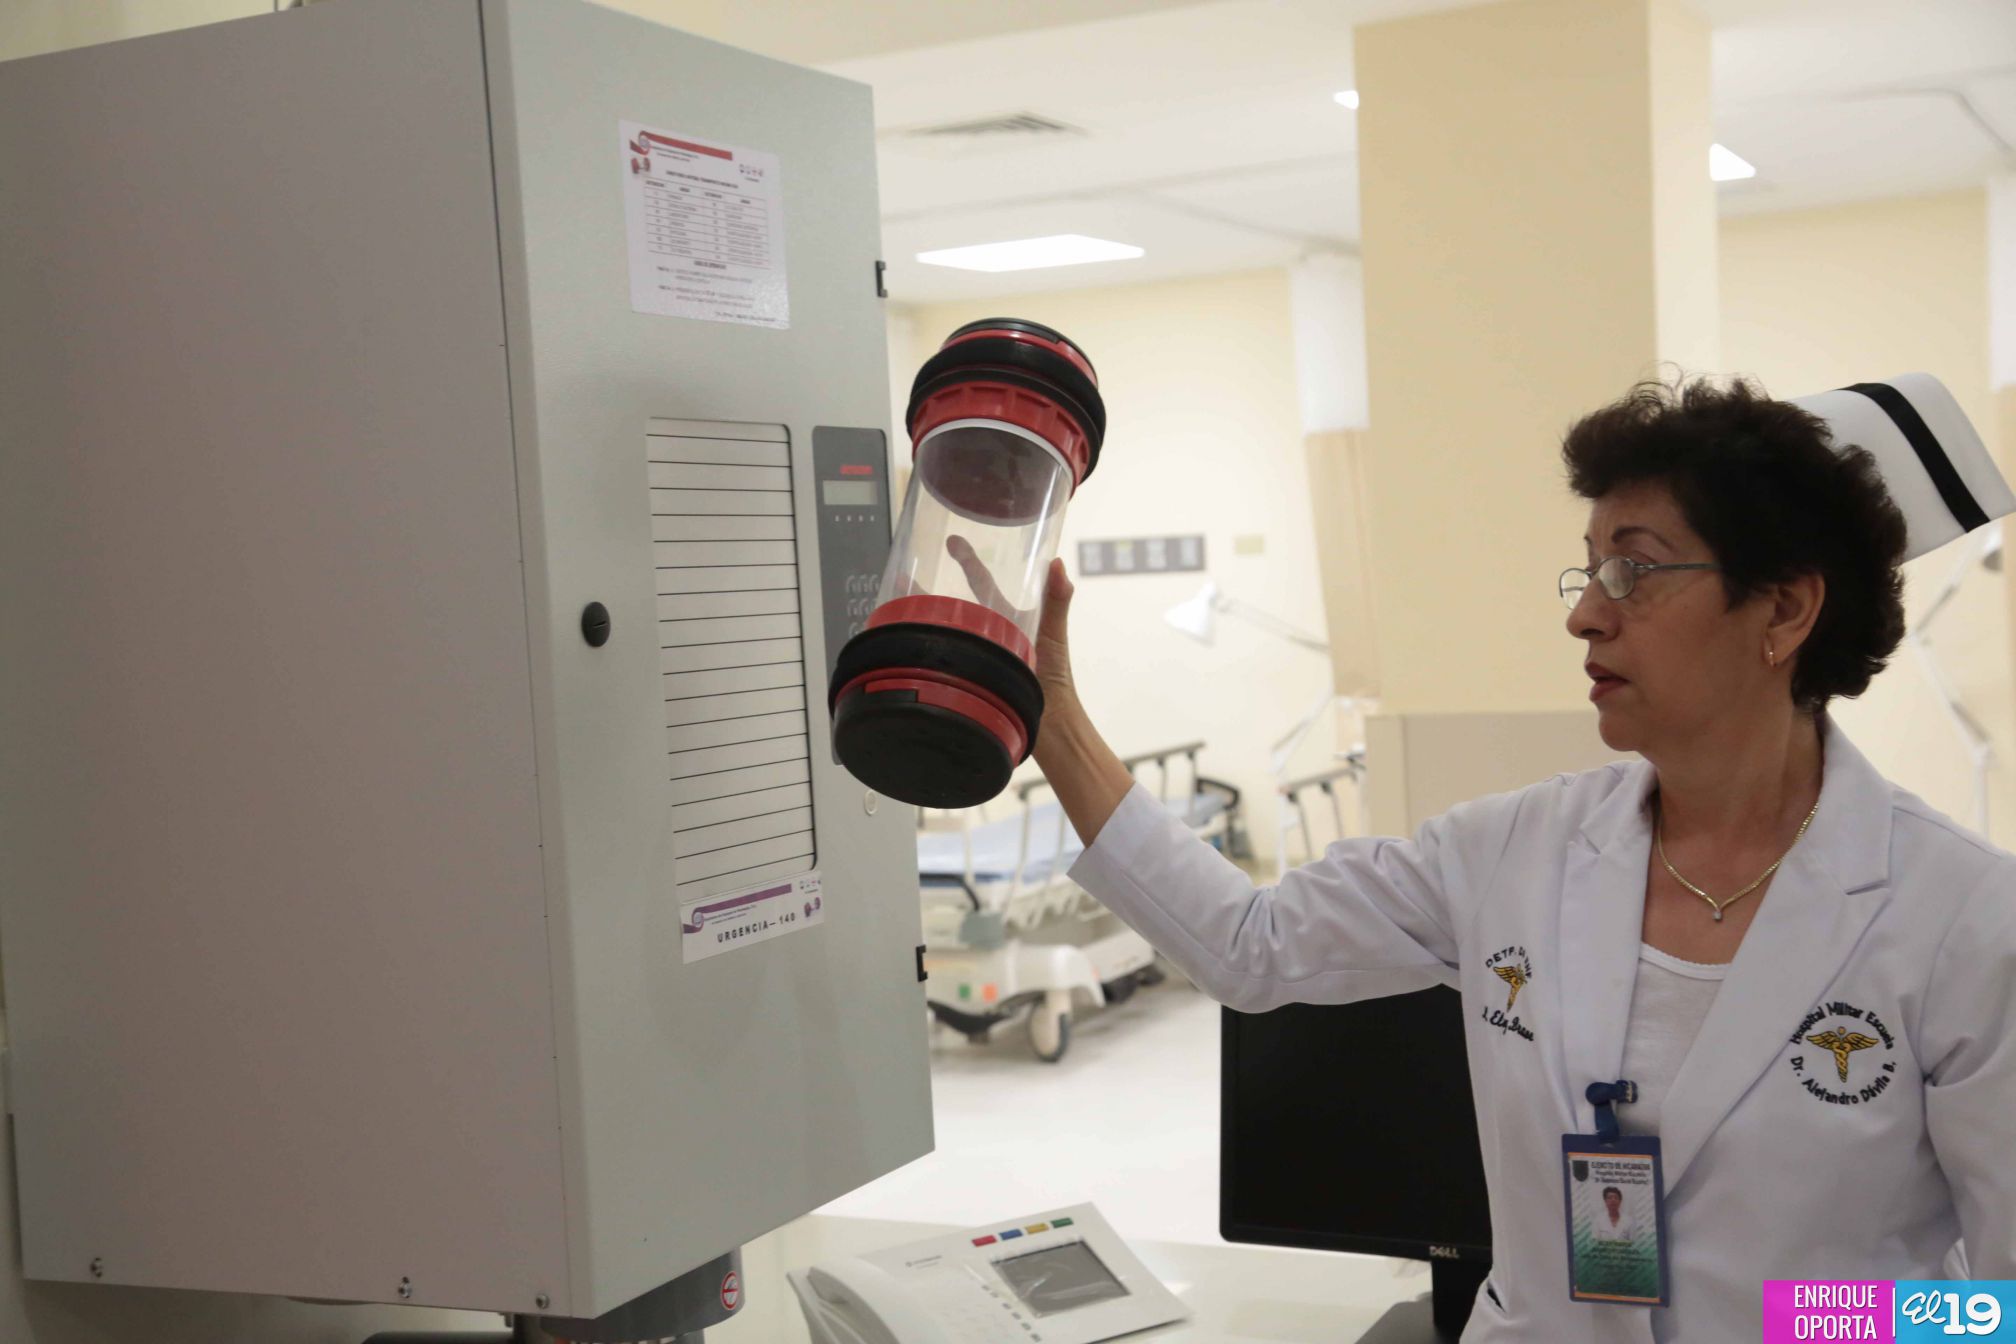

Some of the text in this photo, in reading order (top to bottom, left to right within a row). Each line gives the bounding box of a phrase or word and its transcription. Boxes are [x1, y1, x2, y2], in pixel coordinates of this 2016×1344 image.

[1790, 1006, 1826, 1045] Hospital
[1826, 1002, 1864, 1019] Militar
[1791, 1056, 1804, 1077] Dr.
[1802, 1079, 1859, 1105] Alejandro
[1429, 1245, 1459, 1259] DELL
